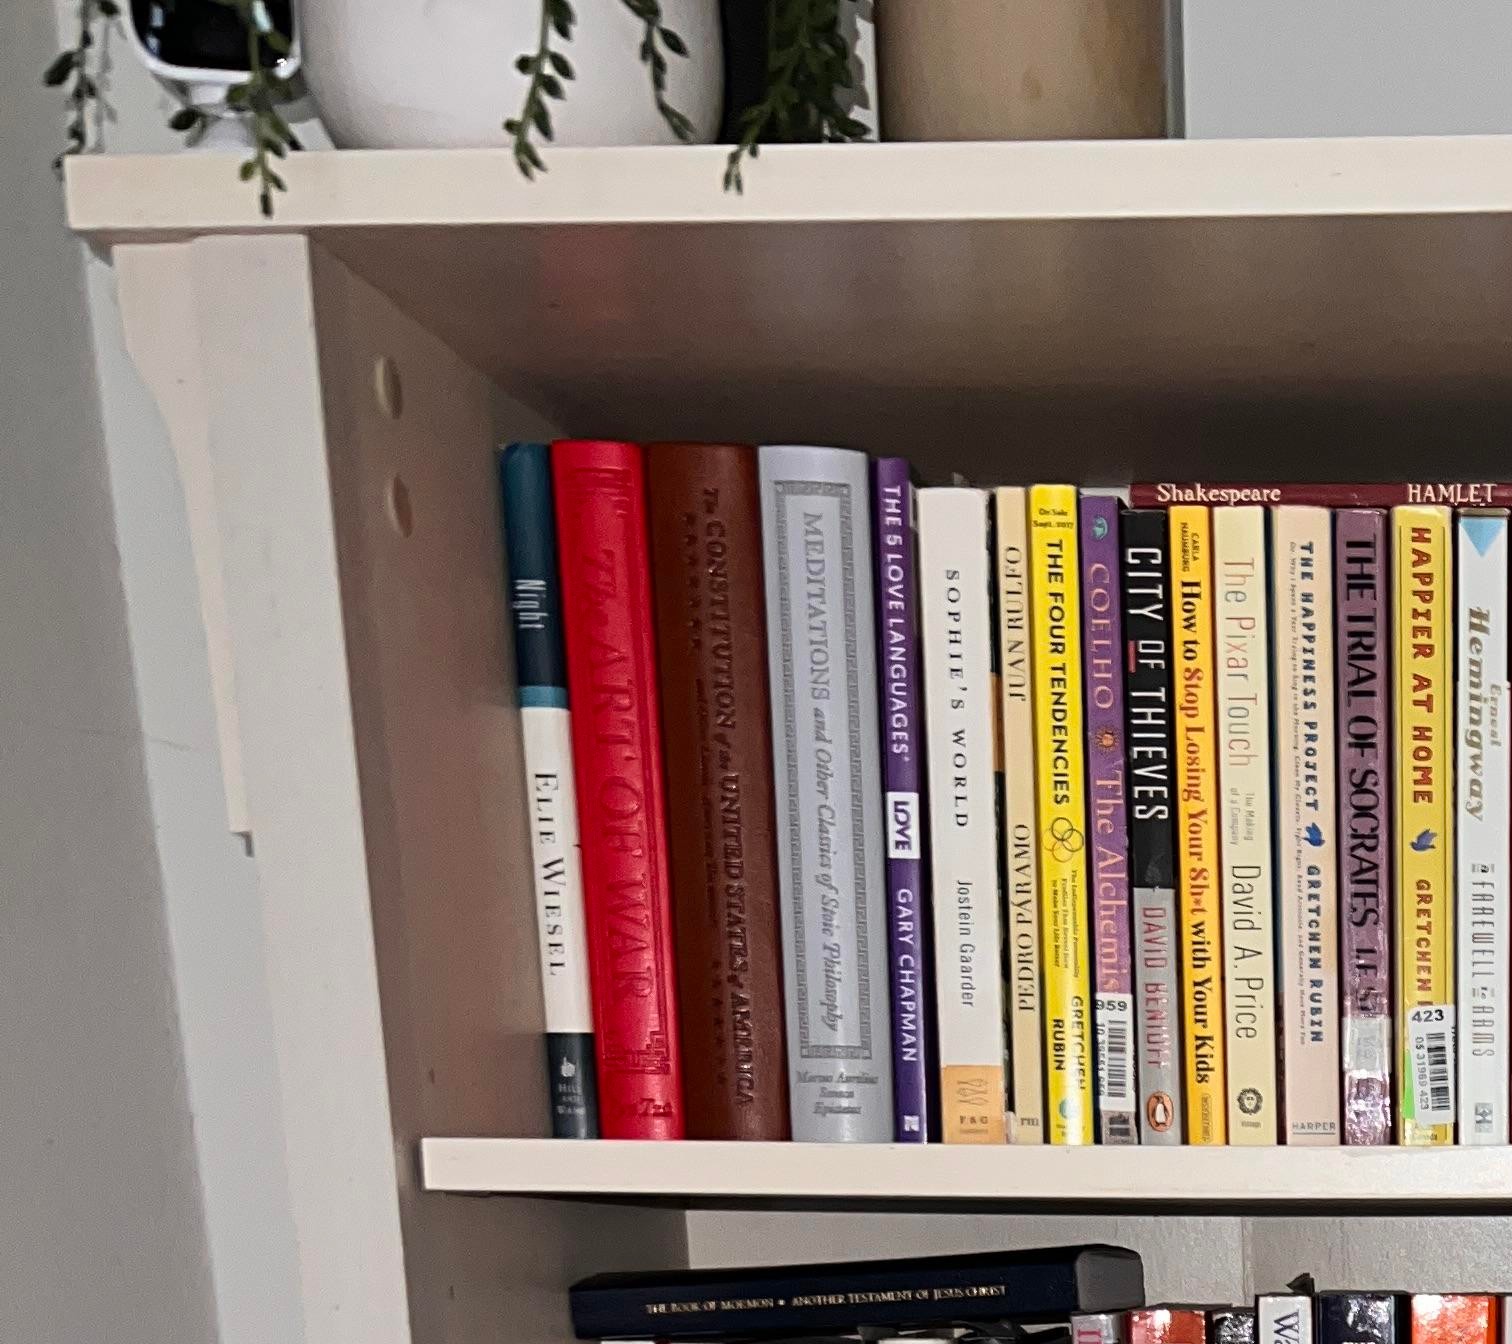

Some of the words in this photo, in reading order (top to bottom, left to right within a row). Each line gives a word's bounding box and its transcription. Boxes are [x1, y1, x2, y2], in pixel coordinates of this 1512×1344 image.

[884, 487, 902, 526] THE
[1157, 485, 1281, 504] Shakespeare
[1407, 484, 1495, 504] HAMLET
[884, 533, 903, 546] 5
[1047, 539, 1064, 584] THE
[513, 578, 545, 630] Night
[885, 555, 904, 611] LOVE
[1127, 547, 1162, 621] CITY
[1223, 558, 1256, 604] The
[1410, 527, 1436, 660] HAPPIER
[946, 569, 968, 711] SOPHIE'S
[1048, 592, 1066, 655] FOUR
[1136, 639, 1162, 670] OF
[1227, 616, 1257, 679] Pixar
[887, 618, 908, 755] LANGUAGES
[1412, 673, 1436, 714] AT
[1464, 606, 1492, 822] Hemingway
[1050, 663, 1071, 806] TENDENCIES
[1131, 687, 1169, 821] THIEVES
[1227, 693, 1258, 767] Touch
[951, 728, 969, 828] WORLD
[1412, 725, 1434, 805] HOME
[534, 771, 562, 845] ELIE
[892, 799, 912, 851] LOVE
[539, 856, 563, 976] WIESEL
[897, 889, 916, 945] GARY
[957, 879, 974, 936] Jostein
[1232, 865, 1262, 932] David
[960, 942, 977, 1007] Gaarder
[1234, 941, 1261, 970] A.
[899, 953, 918, 1063] CHAPMAN
[1235, 978, 1258, 1040] Price
[1411, 1009, 1445, 1023] 423
